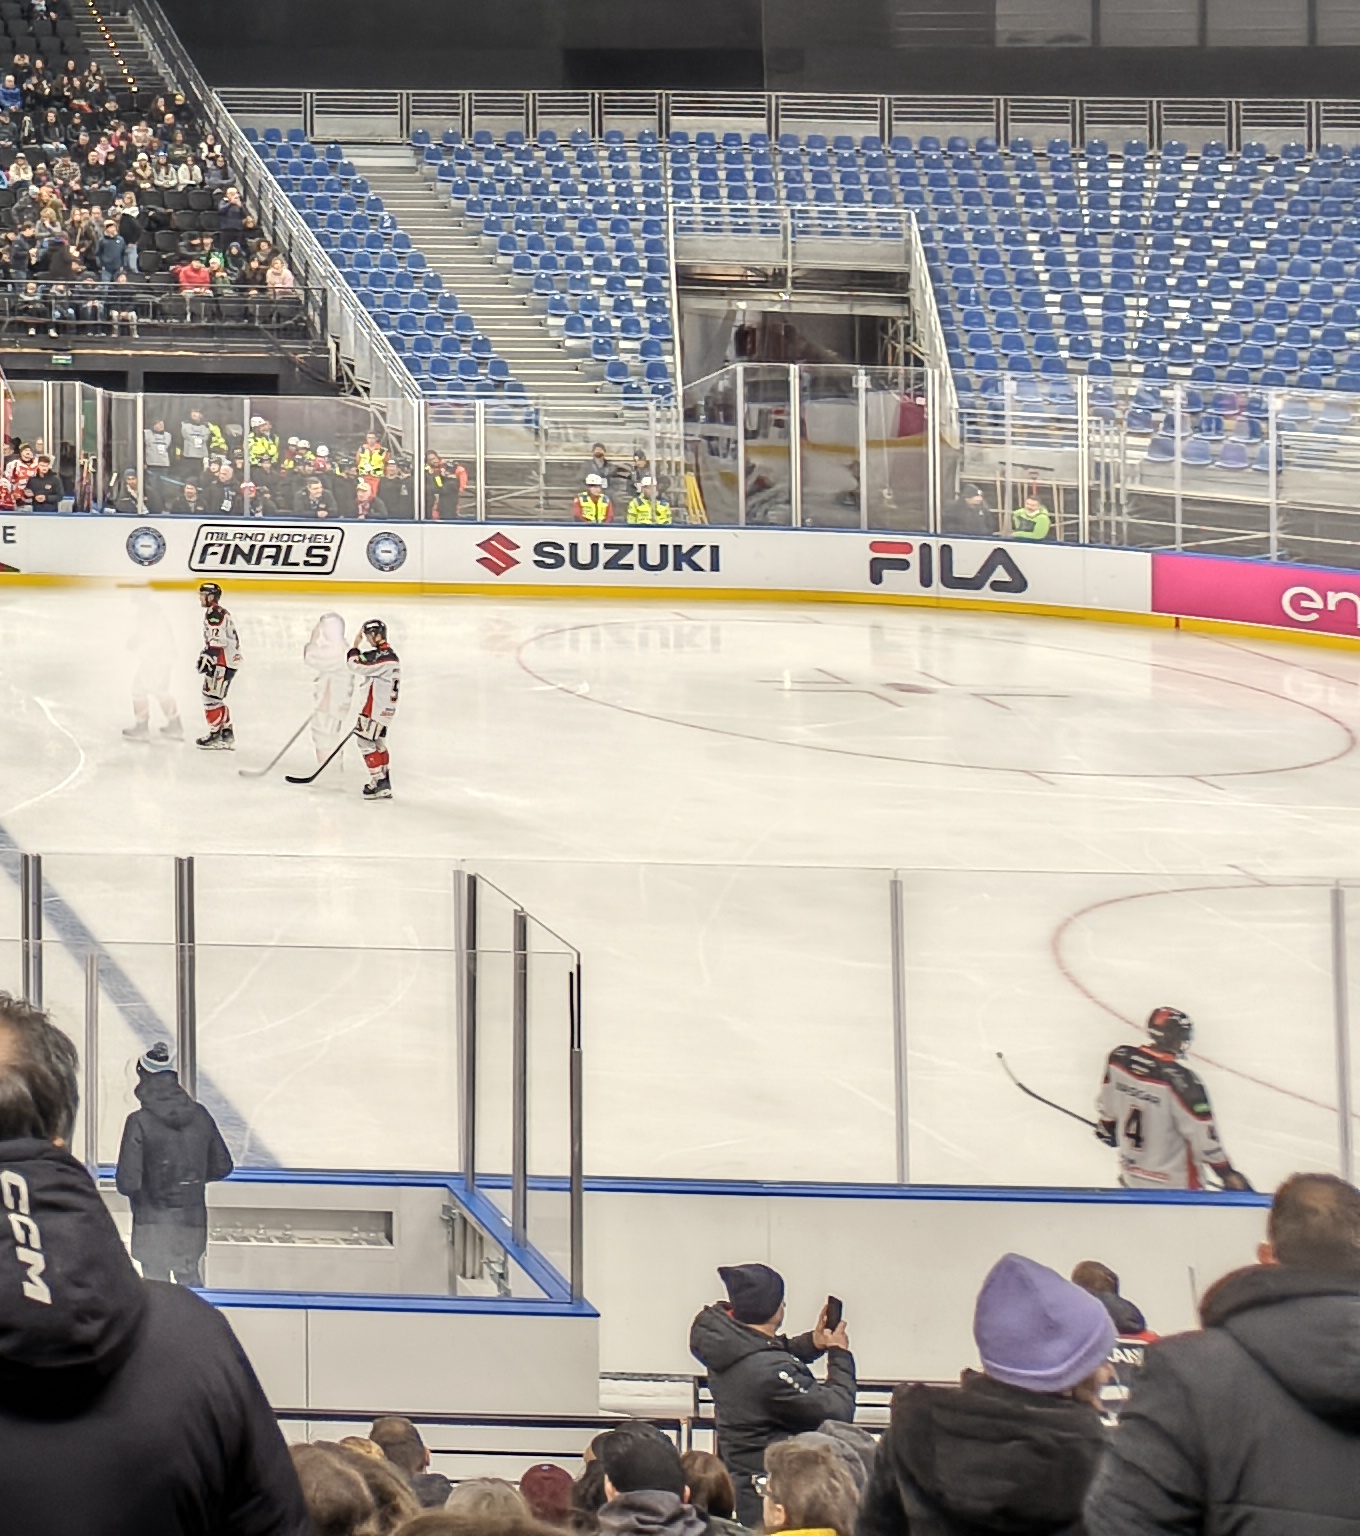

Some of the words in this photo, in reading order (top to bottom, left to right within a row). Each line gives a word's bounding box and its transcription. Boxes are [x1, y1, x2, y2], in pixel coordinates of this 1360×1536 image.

[197, 544, 332, 567] FINALS
[204, 531, 265, 543] MILANO
[269, 533, 334, 544] HOCKEY
[533, 540, 721, 573] SUZUKI
[869, 540, 1028, 594] FILA
[1281, 586, 1360, 629] en
[1123, 1105, 1145, 1151] 4
[0, 1170, 52, 1305] CCM
